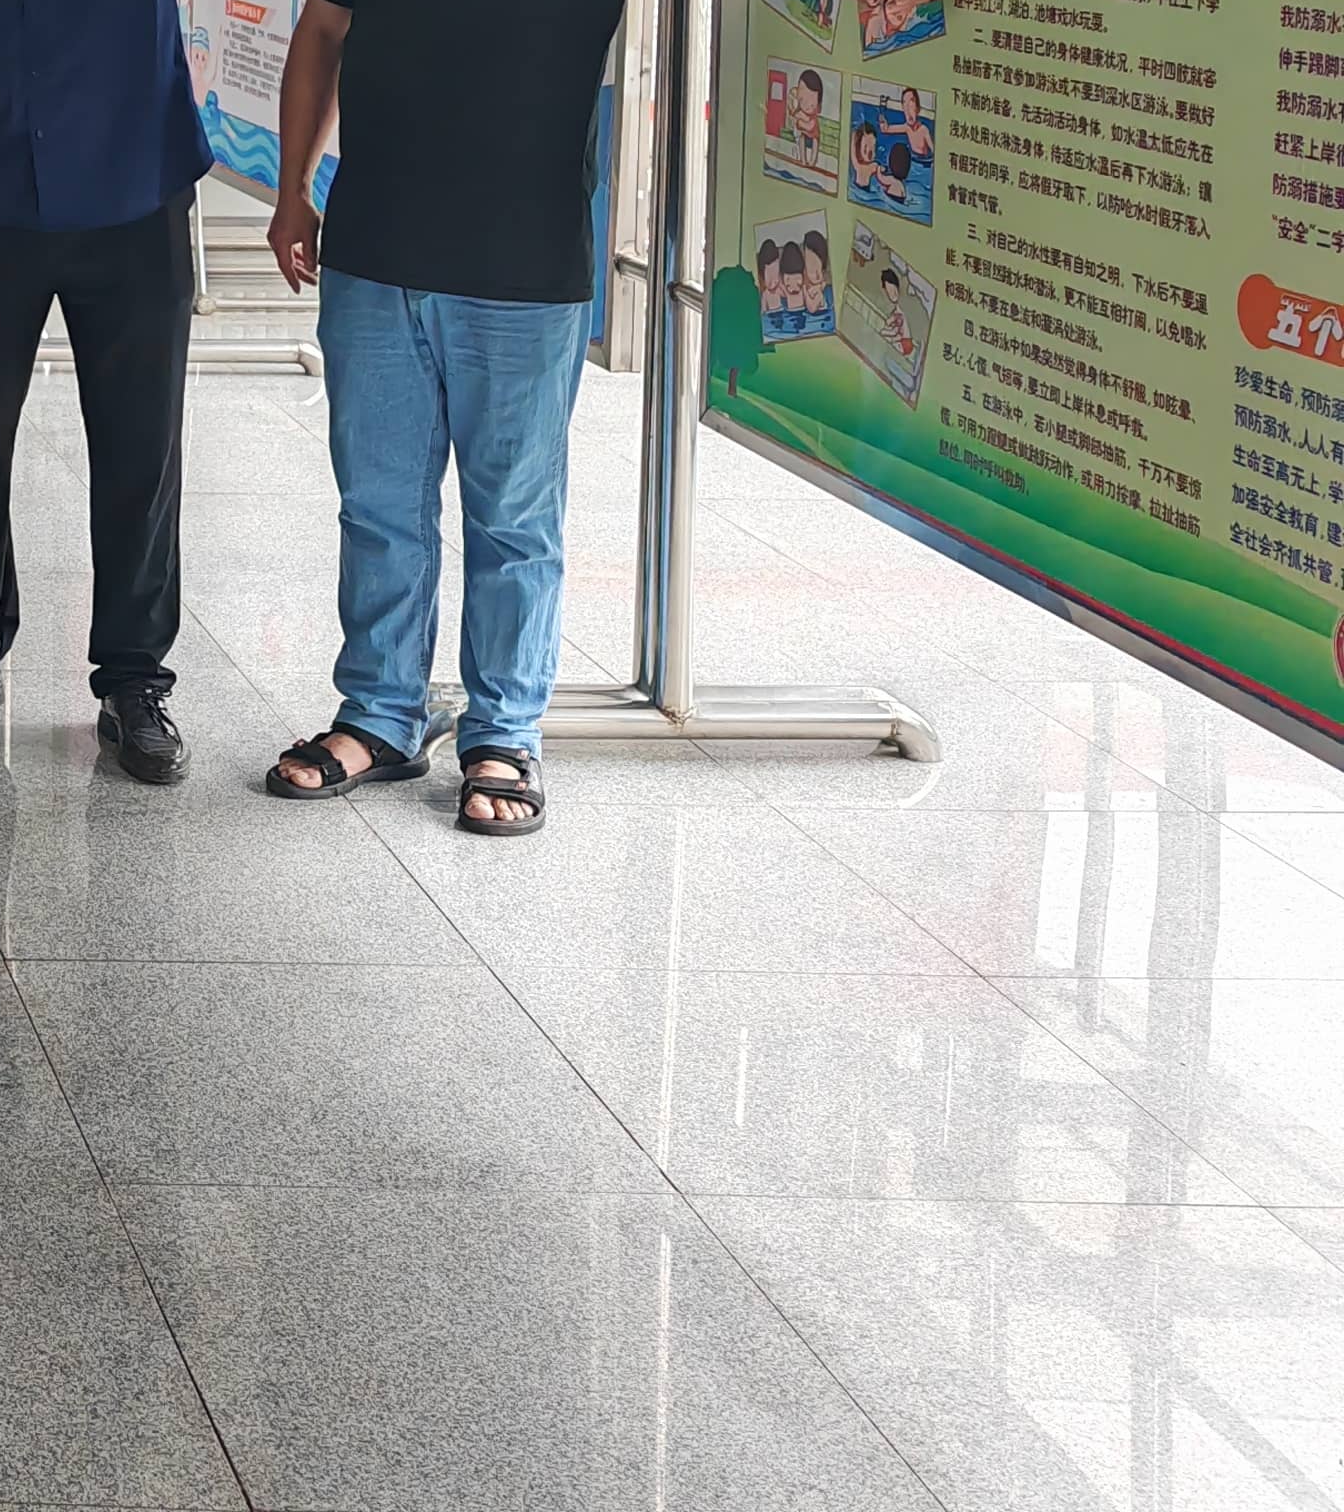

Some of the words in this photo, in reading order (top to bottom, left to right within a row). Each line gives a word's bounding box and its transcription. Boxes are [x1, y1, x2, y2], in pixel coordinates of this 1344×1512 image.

[1279, 4, 1344, 36] 我防溺水
[1278, 46, 1344, 80] 伸手踢脚
[1230, 520, 1344, 591] 全社会齐抓共管，
